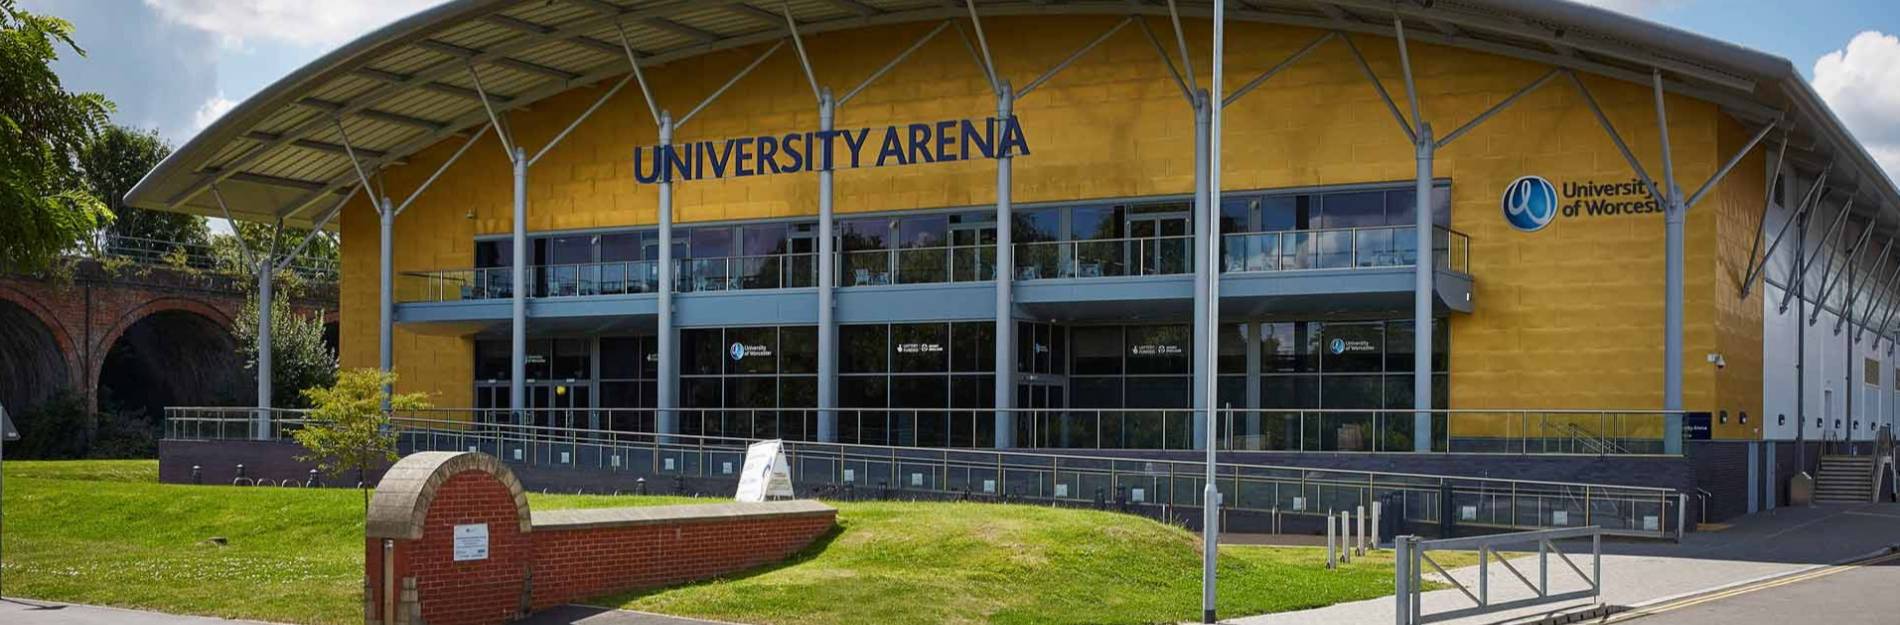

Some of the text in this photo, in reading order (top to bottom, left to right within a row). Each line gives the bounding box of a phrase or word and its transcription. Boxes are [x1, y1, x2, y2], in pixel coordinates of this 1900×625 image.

[634, 115, 1030, 184] UNIVERSITY ARENA
[1562, 199, 1665, 217] of Worcest
